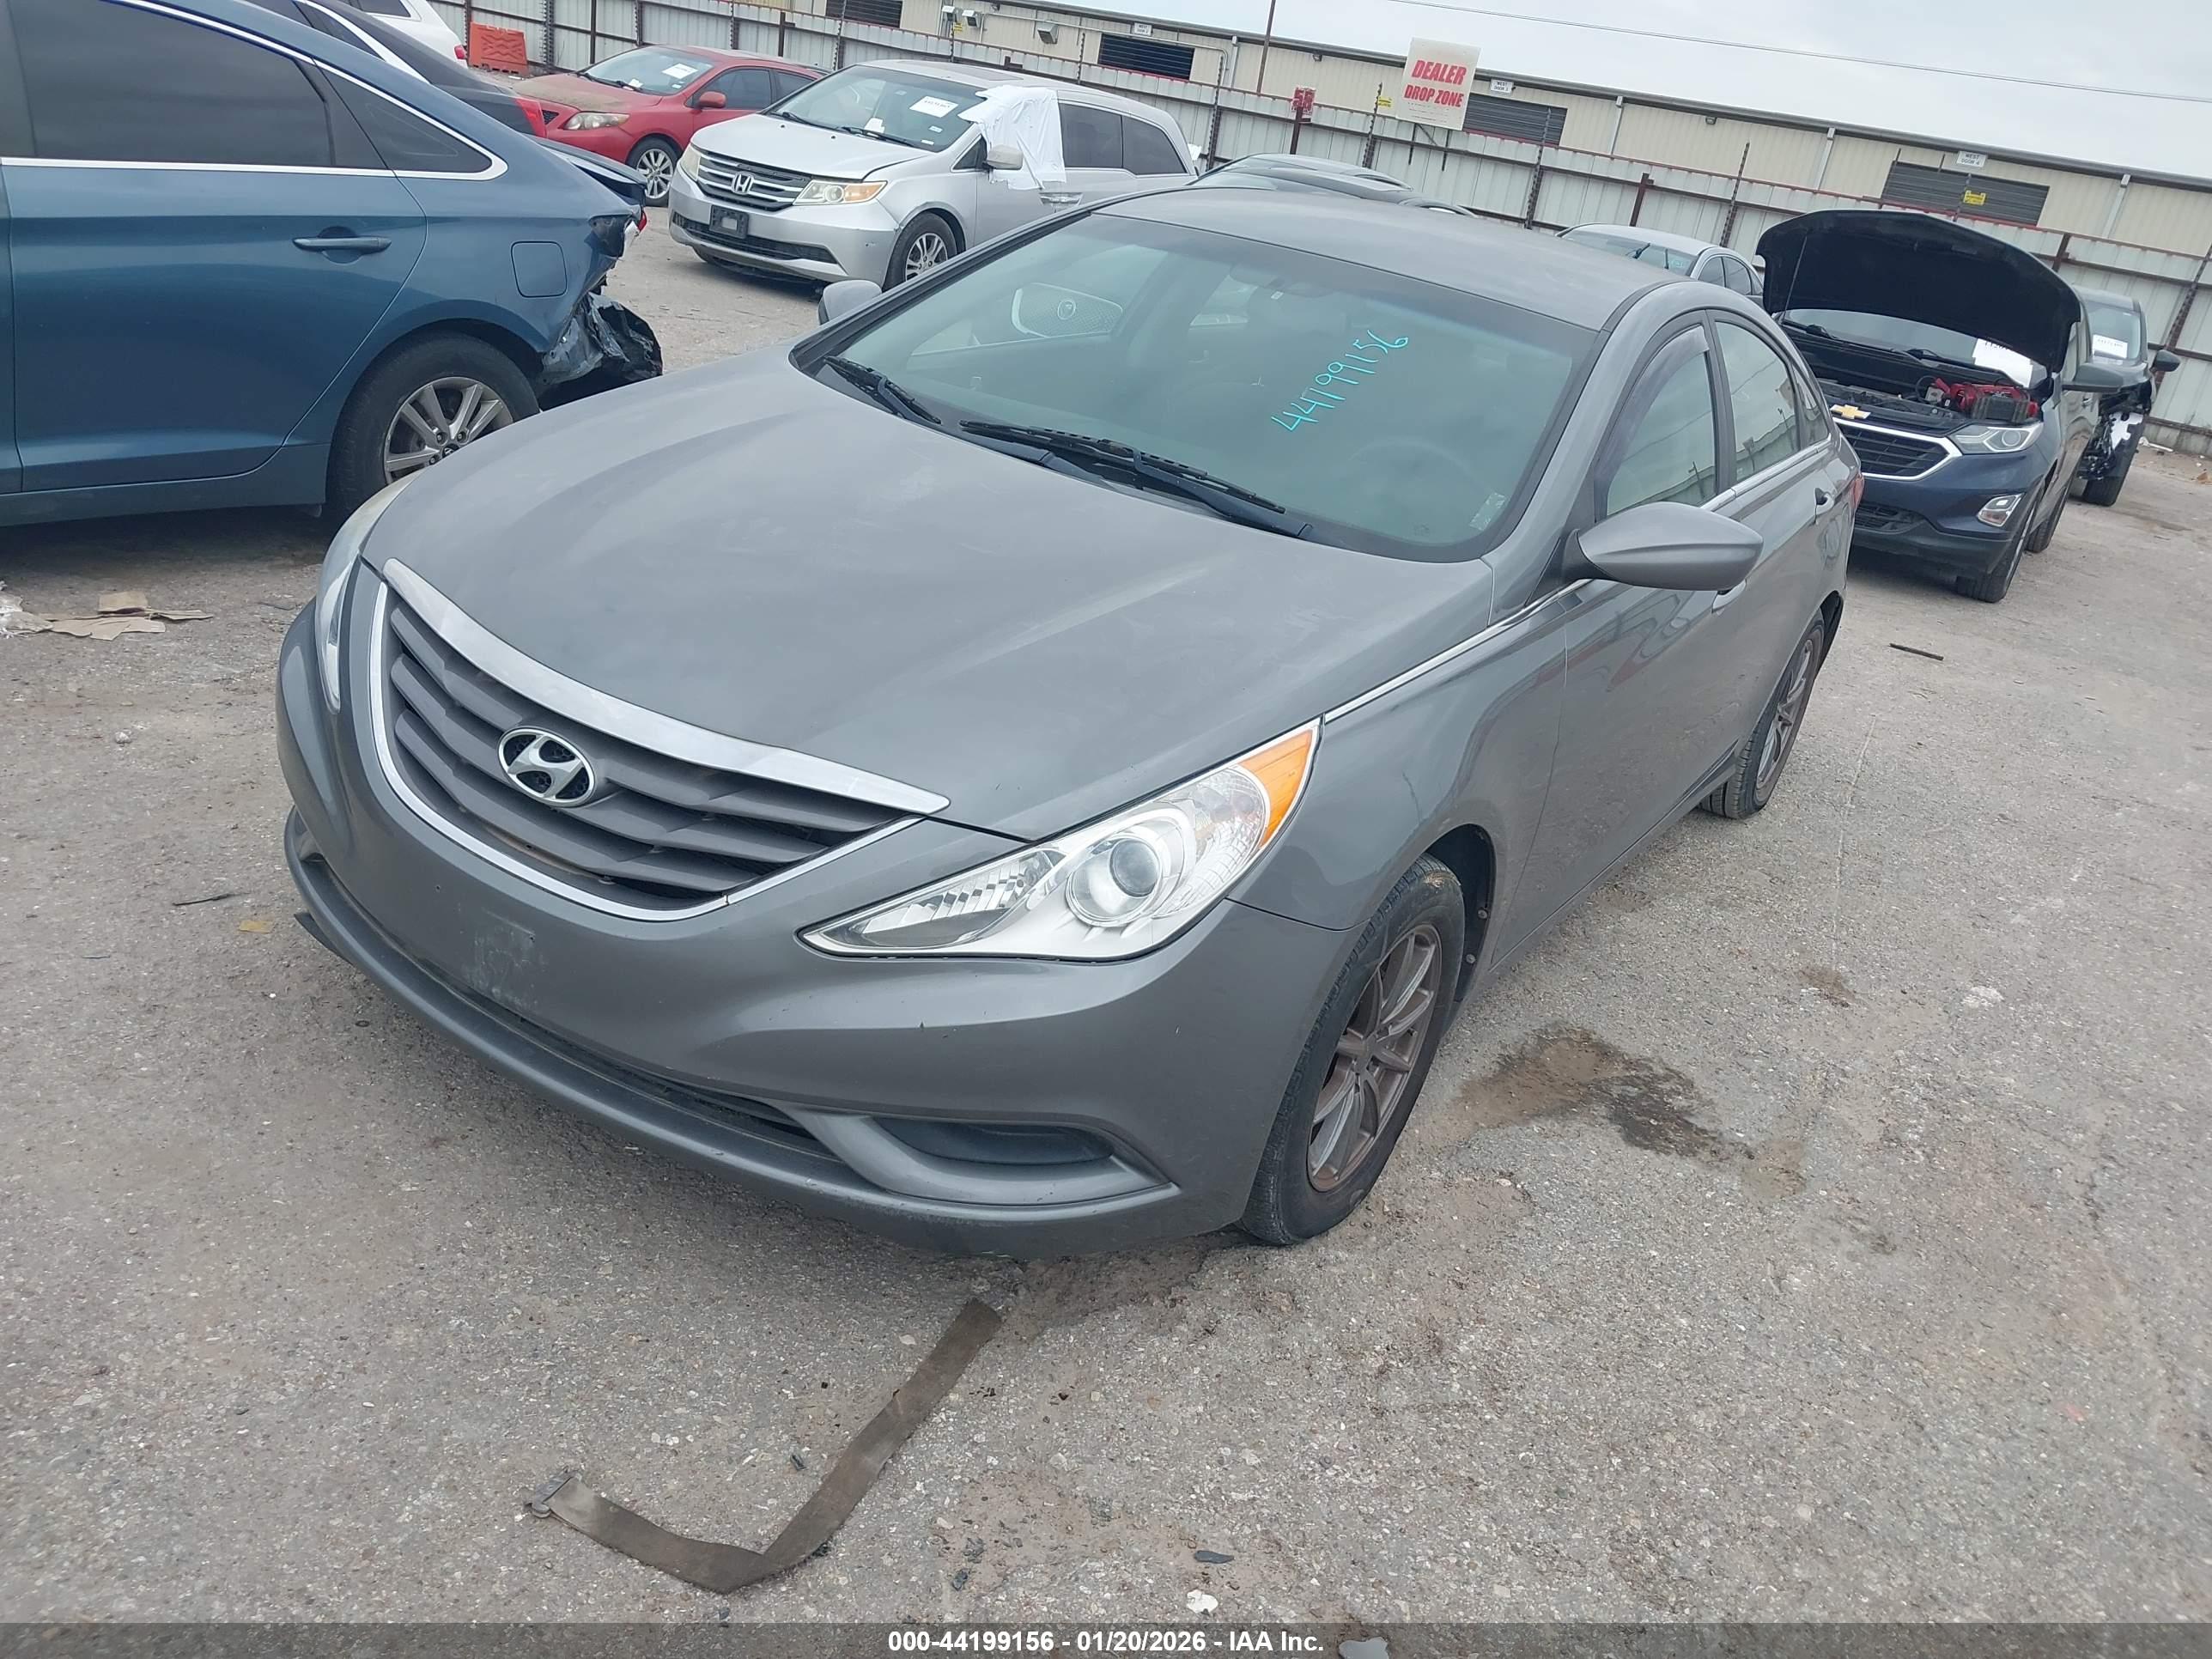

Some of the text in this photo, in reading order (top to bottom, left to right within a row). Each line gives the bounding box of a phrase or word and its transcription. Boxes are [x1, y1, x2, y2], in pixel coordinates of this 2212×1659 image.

[1412, 59, 1467, 85] DEALER
[1404, 84, 1435, 102] DROP
[1434, 90, 1464, 107] ZONE
[1271, 329, 1408, 430] 44199156
